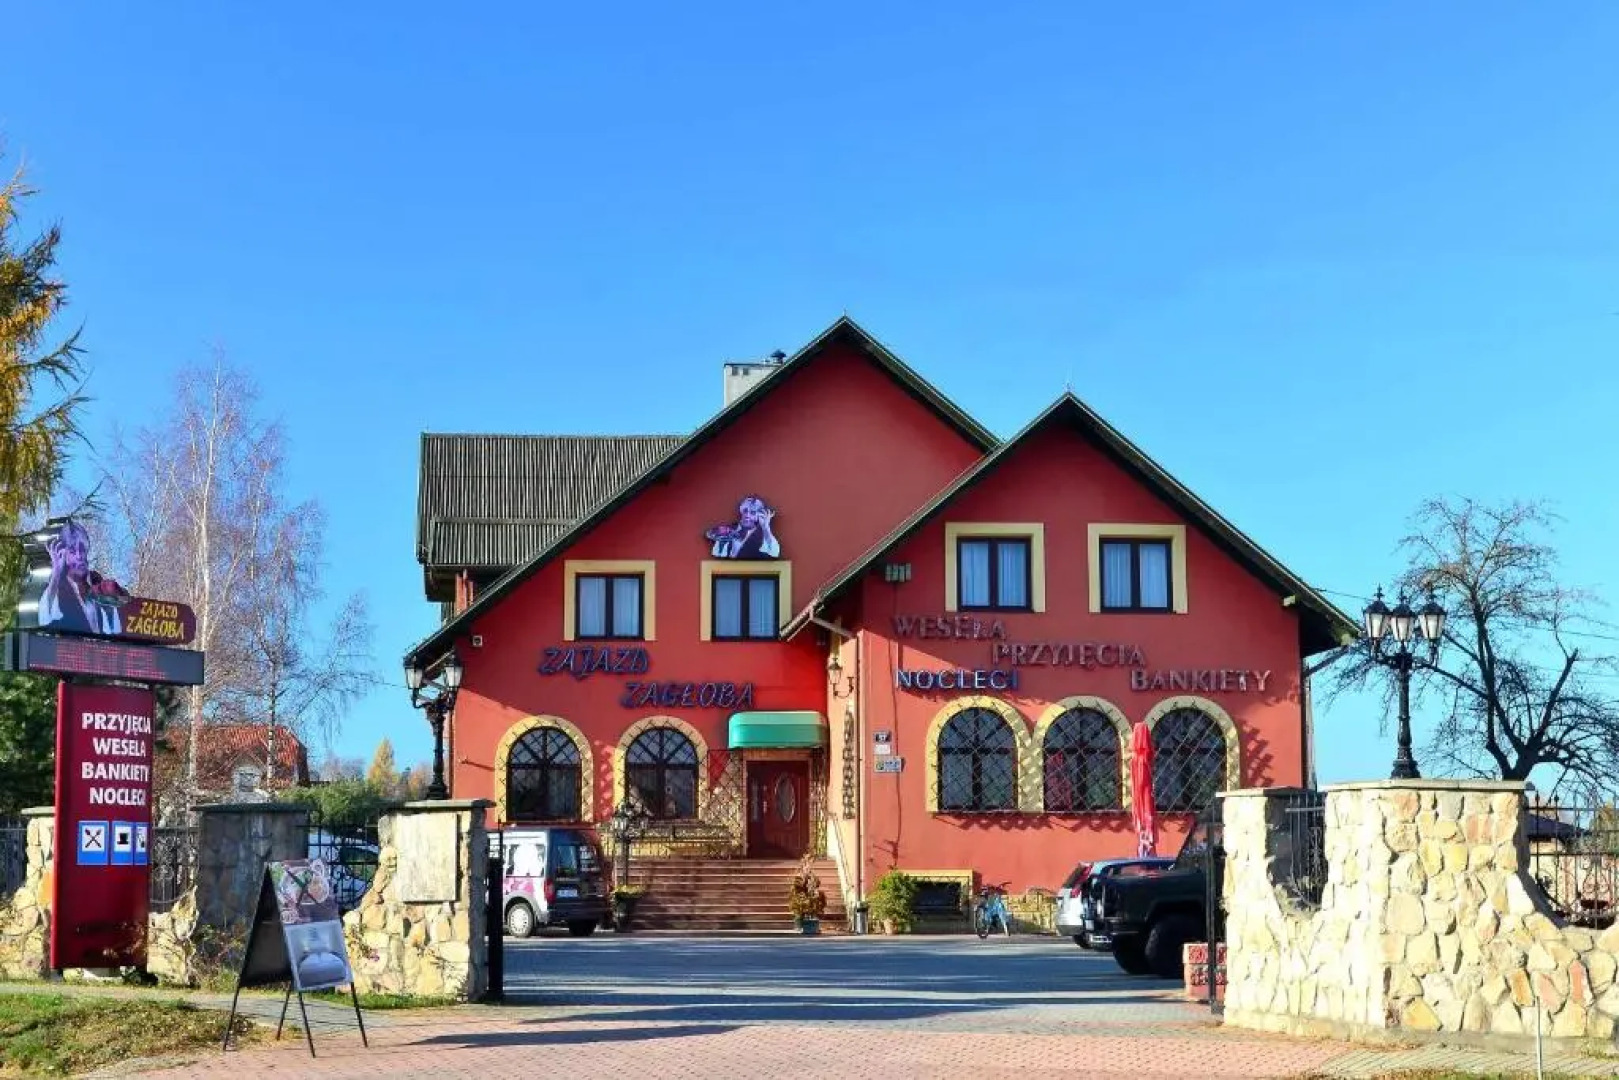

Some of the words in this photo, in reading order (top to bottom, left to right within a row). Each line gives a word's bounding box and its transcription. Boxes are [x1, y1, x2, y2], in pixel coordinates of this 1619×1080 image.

[141, 602, 178, 619] ZAJAZD
[539, 647, 650, 680] ZAJAZD
[991, 641, 1147, 671] PRZYJĘCIA
[895, 668, 1020, 690] NOCLEGI
[1130, 668, 1272, 693] BANKIETY
[620, 682, 757, 709] ZAGŁOBA
[81, 712, 151, 735] PRZYJĘCIA
[92, 737, 146, 757] WESELA
